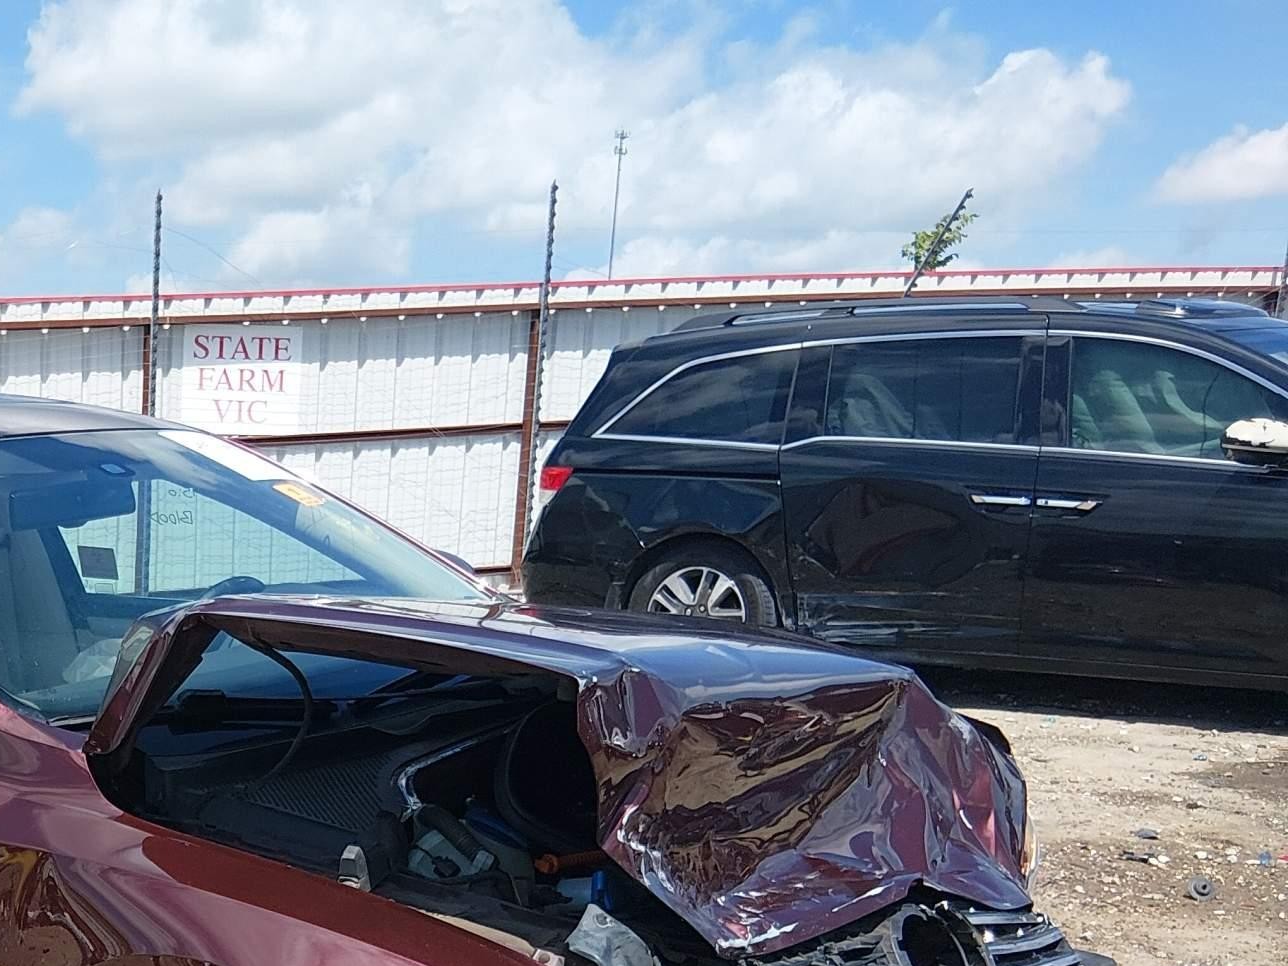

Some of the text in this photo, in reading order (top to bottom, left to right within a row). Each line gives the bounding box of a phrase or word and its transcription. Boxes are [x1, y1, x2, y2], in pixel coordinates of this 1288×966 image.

[193, 334, 292, 361] STATE
[198, 367, 286, 393] FARM
[214, 399, 268, 424] VIC
